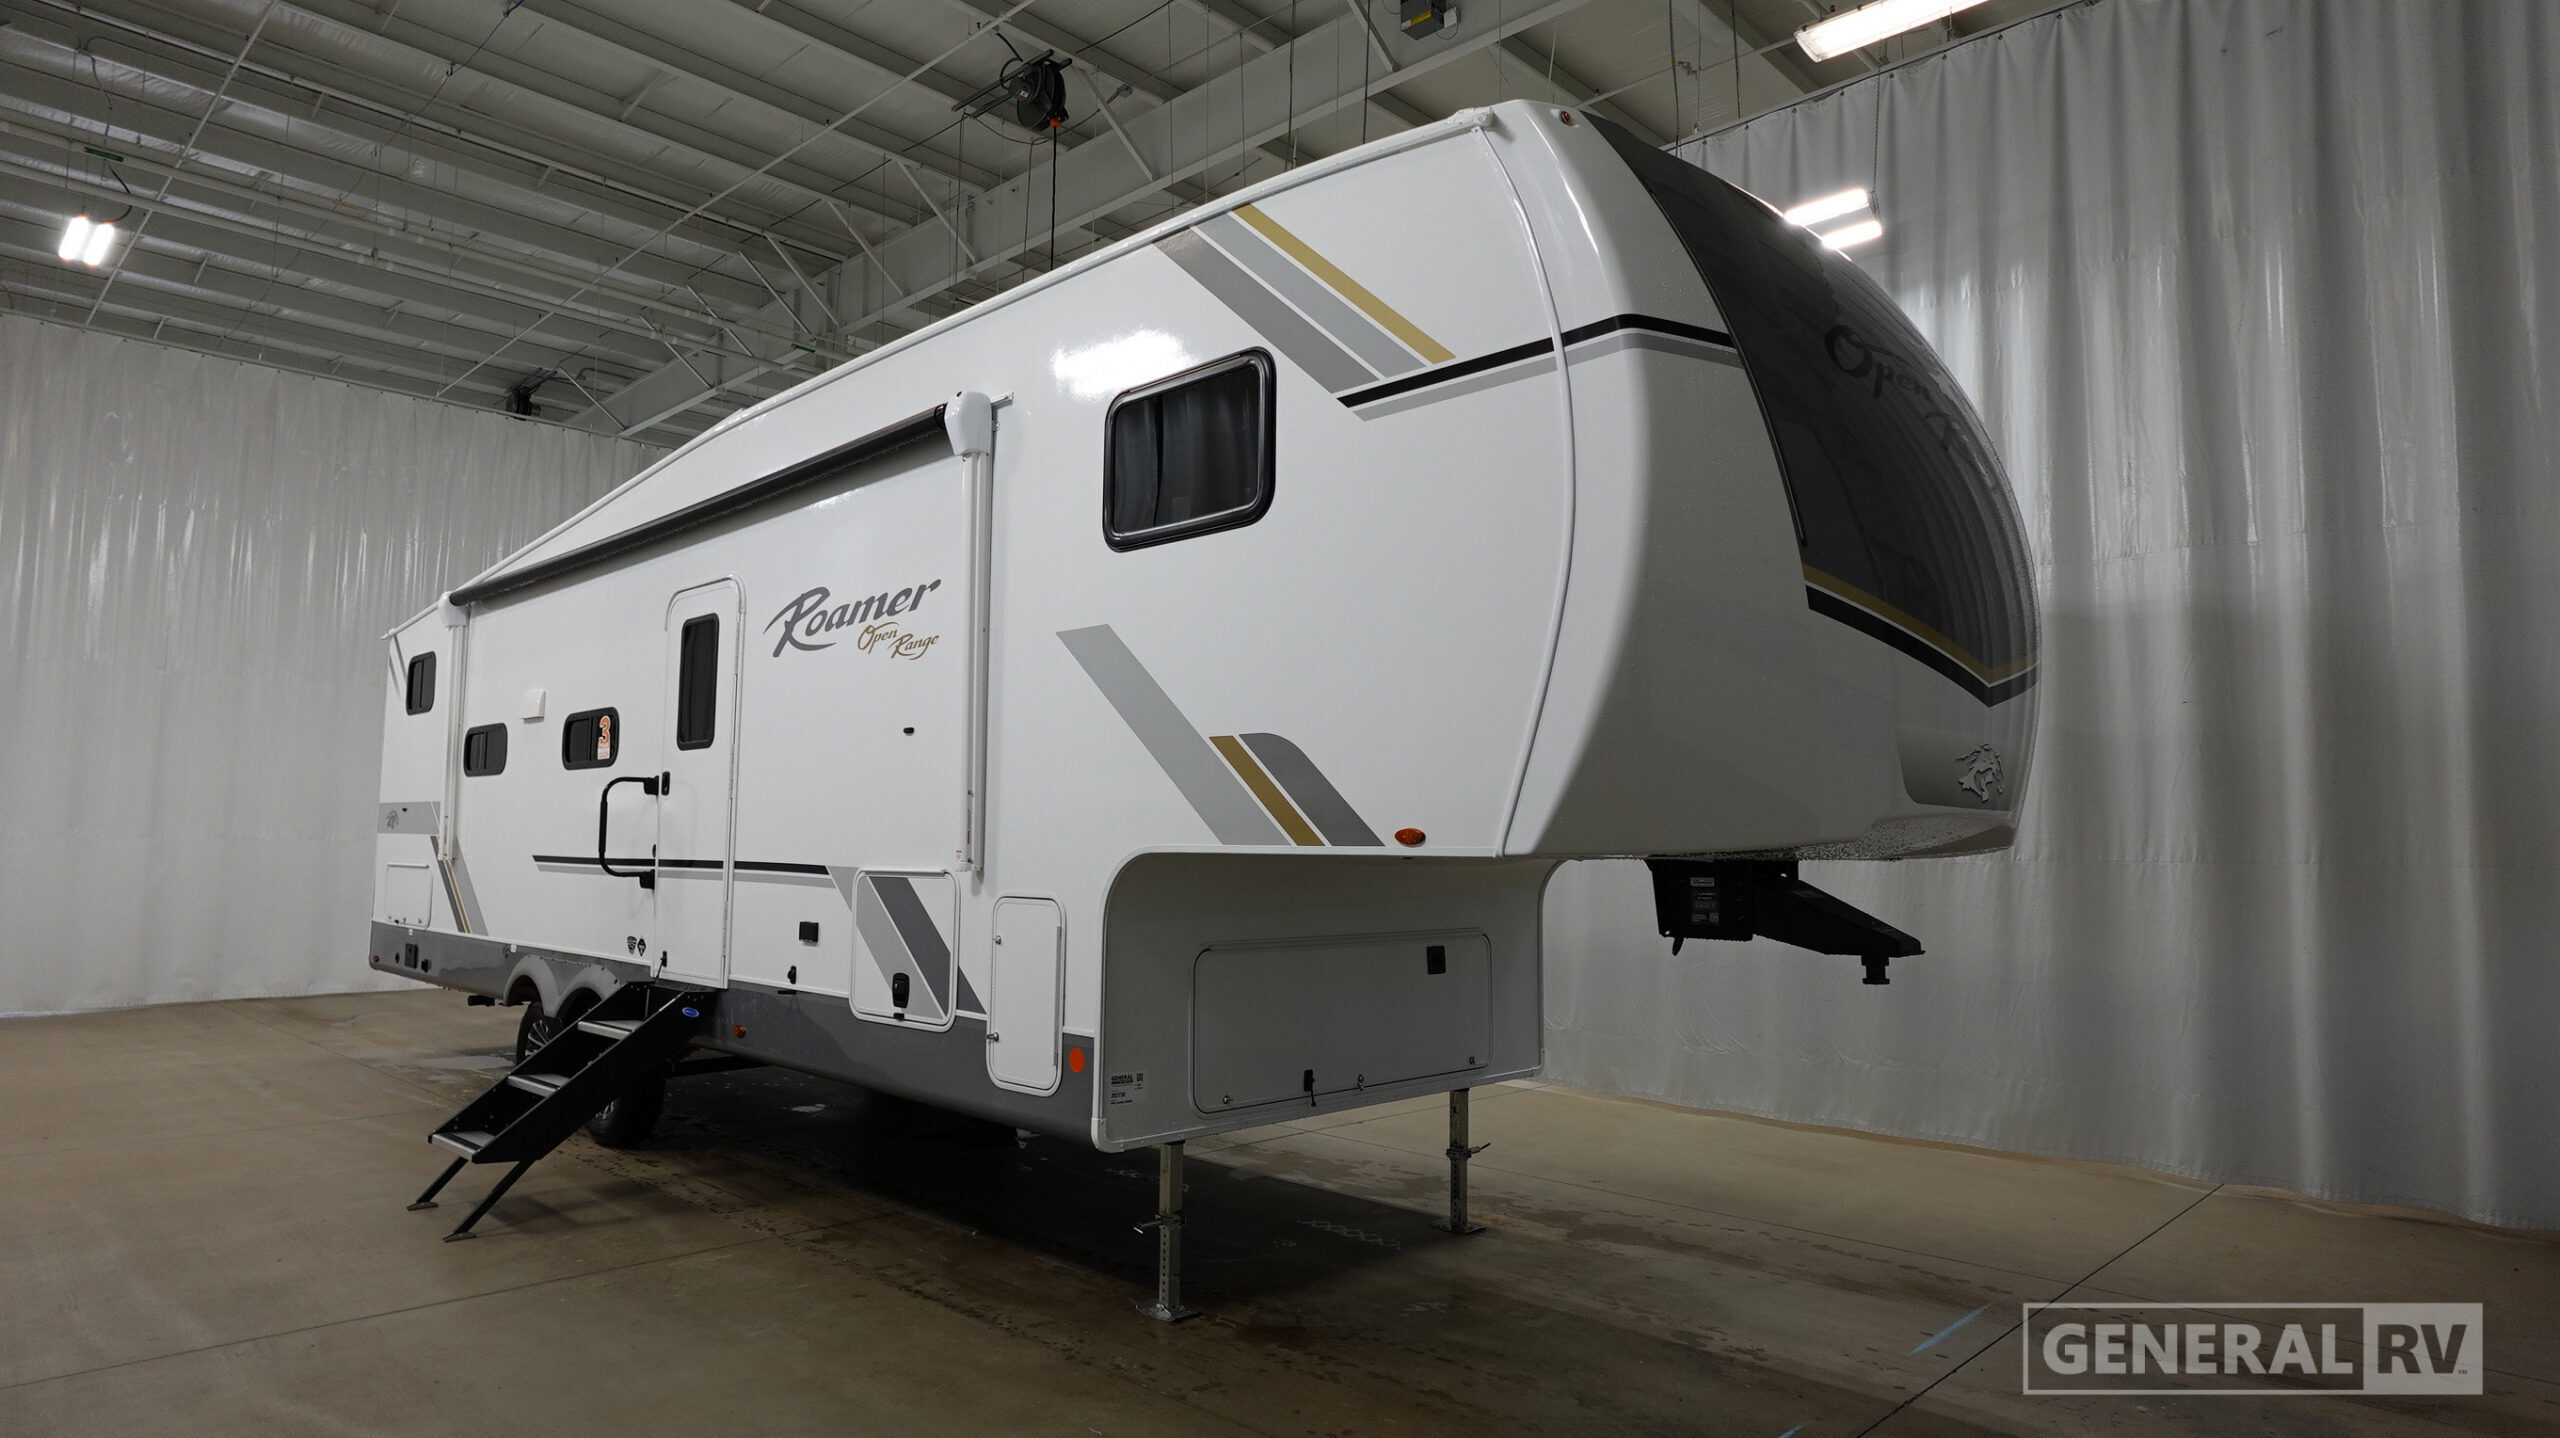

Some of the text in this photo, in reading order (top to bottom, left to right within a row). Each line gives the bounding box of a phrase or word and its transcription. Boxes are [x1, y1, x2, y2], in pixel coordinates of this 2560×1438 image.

[1824, 324, 1931, 400] Open
[763, 579, 941, 658] Roamer
[857, 621, 940, 660] Open Range
[599, 716, 610, 744] 3
